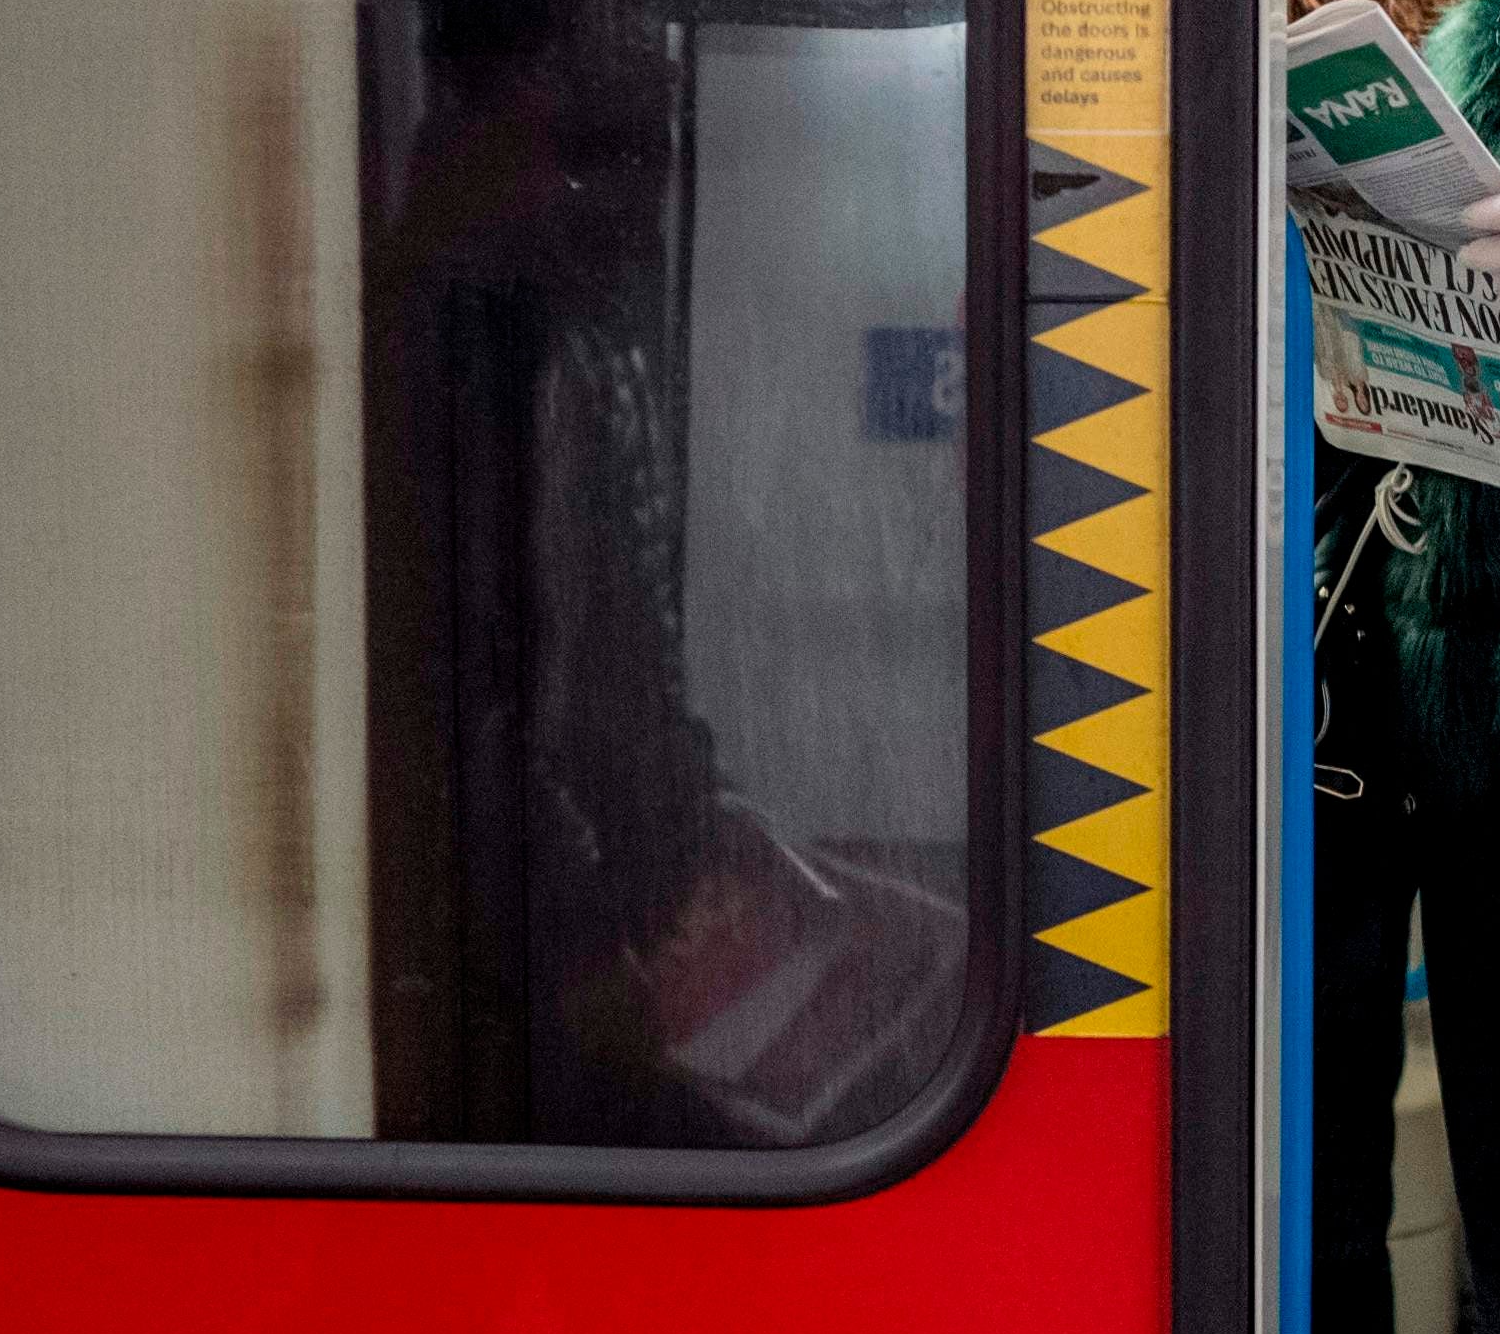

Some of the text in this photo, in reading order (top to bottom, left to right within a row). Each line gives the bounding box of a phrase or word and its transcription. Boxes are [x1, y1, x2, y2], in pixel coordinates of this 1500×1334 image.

[1041, 0, 1150, 19] Obstructing
[1041, 22, 1150, 38] the doors is
[1041, 46, 1136, 63] dangerous
[1041, 68, 1142, 83] and causes
[1041, 89, 1099, 107] delays
[1360, 272, 1454, 335] FACES
[1370, 385, 1495, 445] Standard
